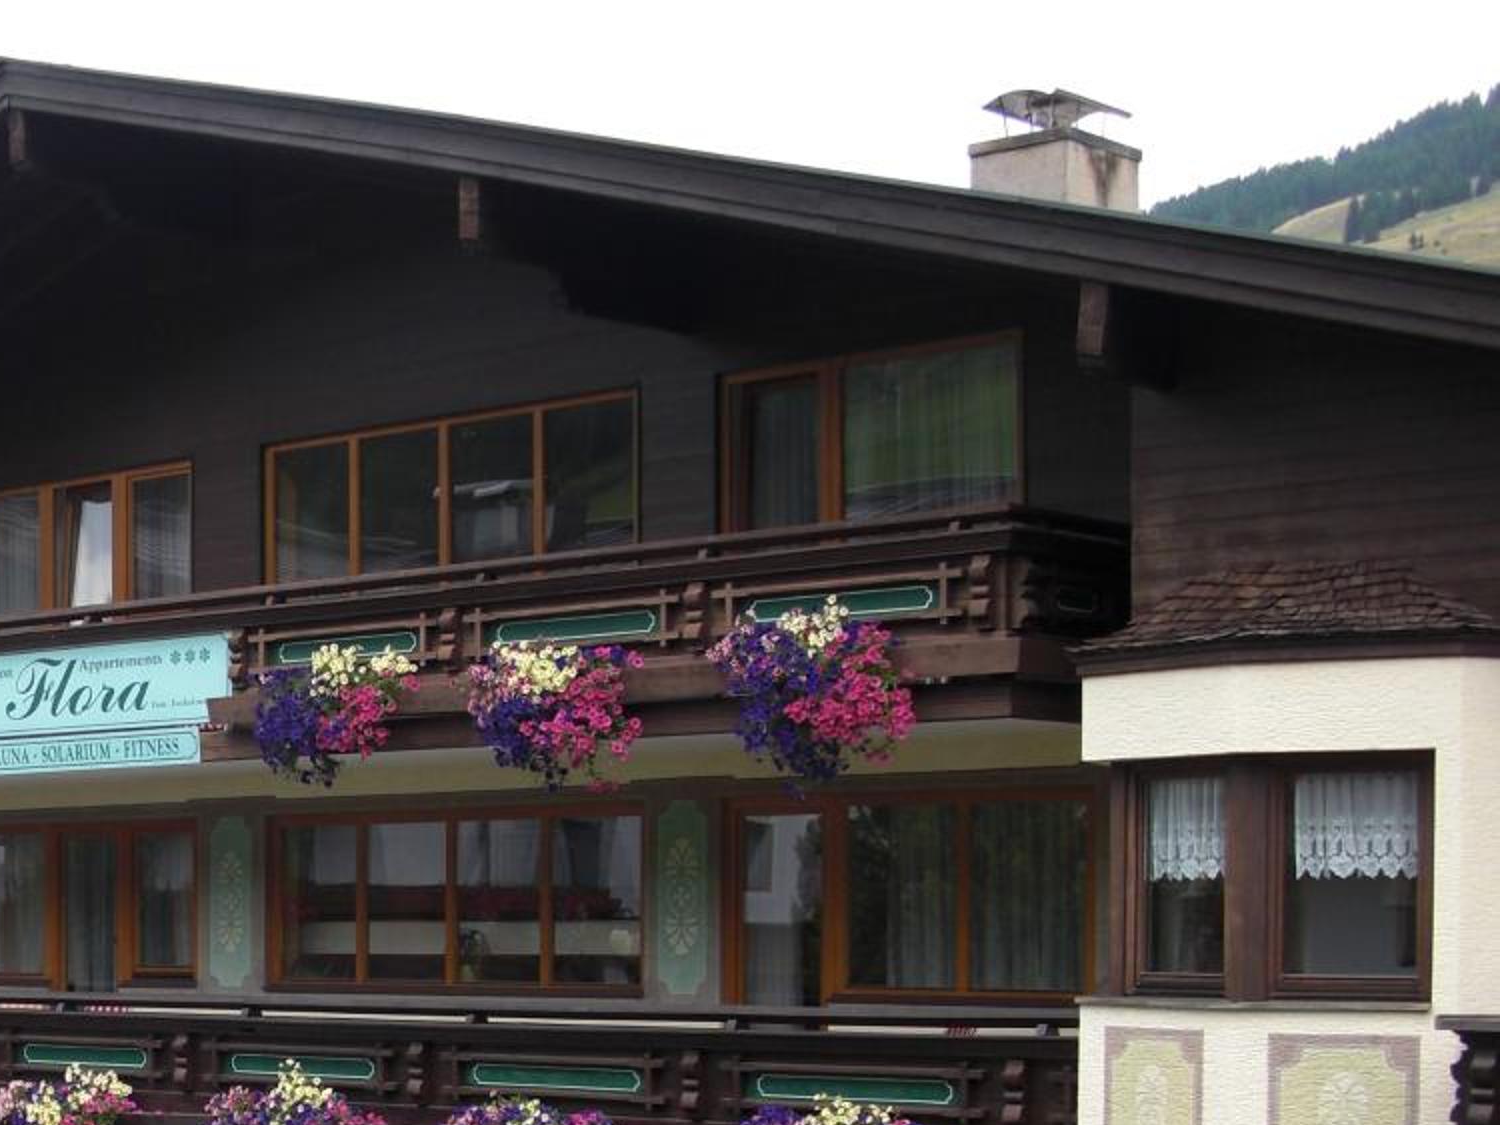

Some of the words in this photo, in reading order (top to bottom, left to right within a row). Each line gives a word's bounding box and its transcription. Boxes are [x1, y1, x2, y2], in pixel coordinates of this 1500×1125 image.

[79, 655, 163, 673] Appartements
[5, 658, 150, 721] Flora
[41, 742, 112, 764] SOLARIUM
[123, 737, 180, 759] FITNESS
